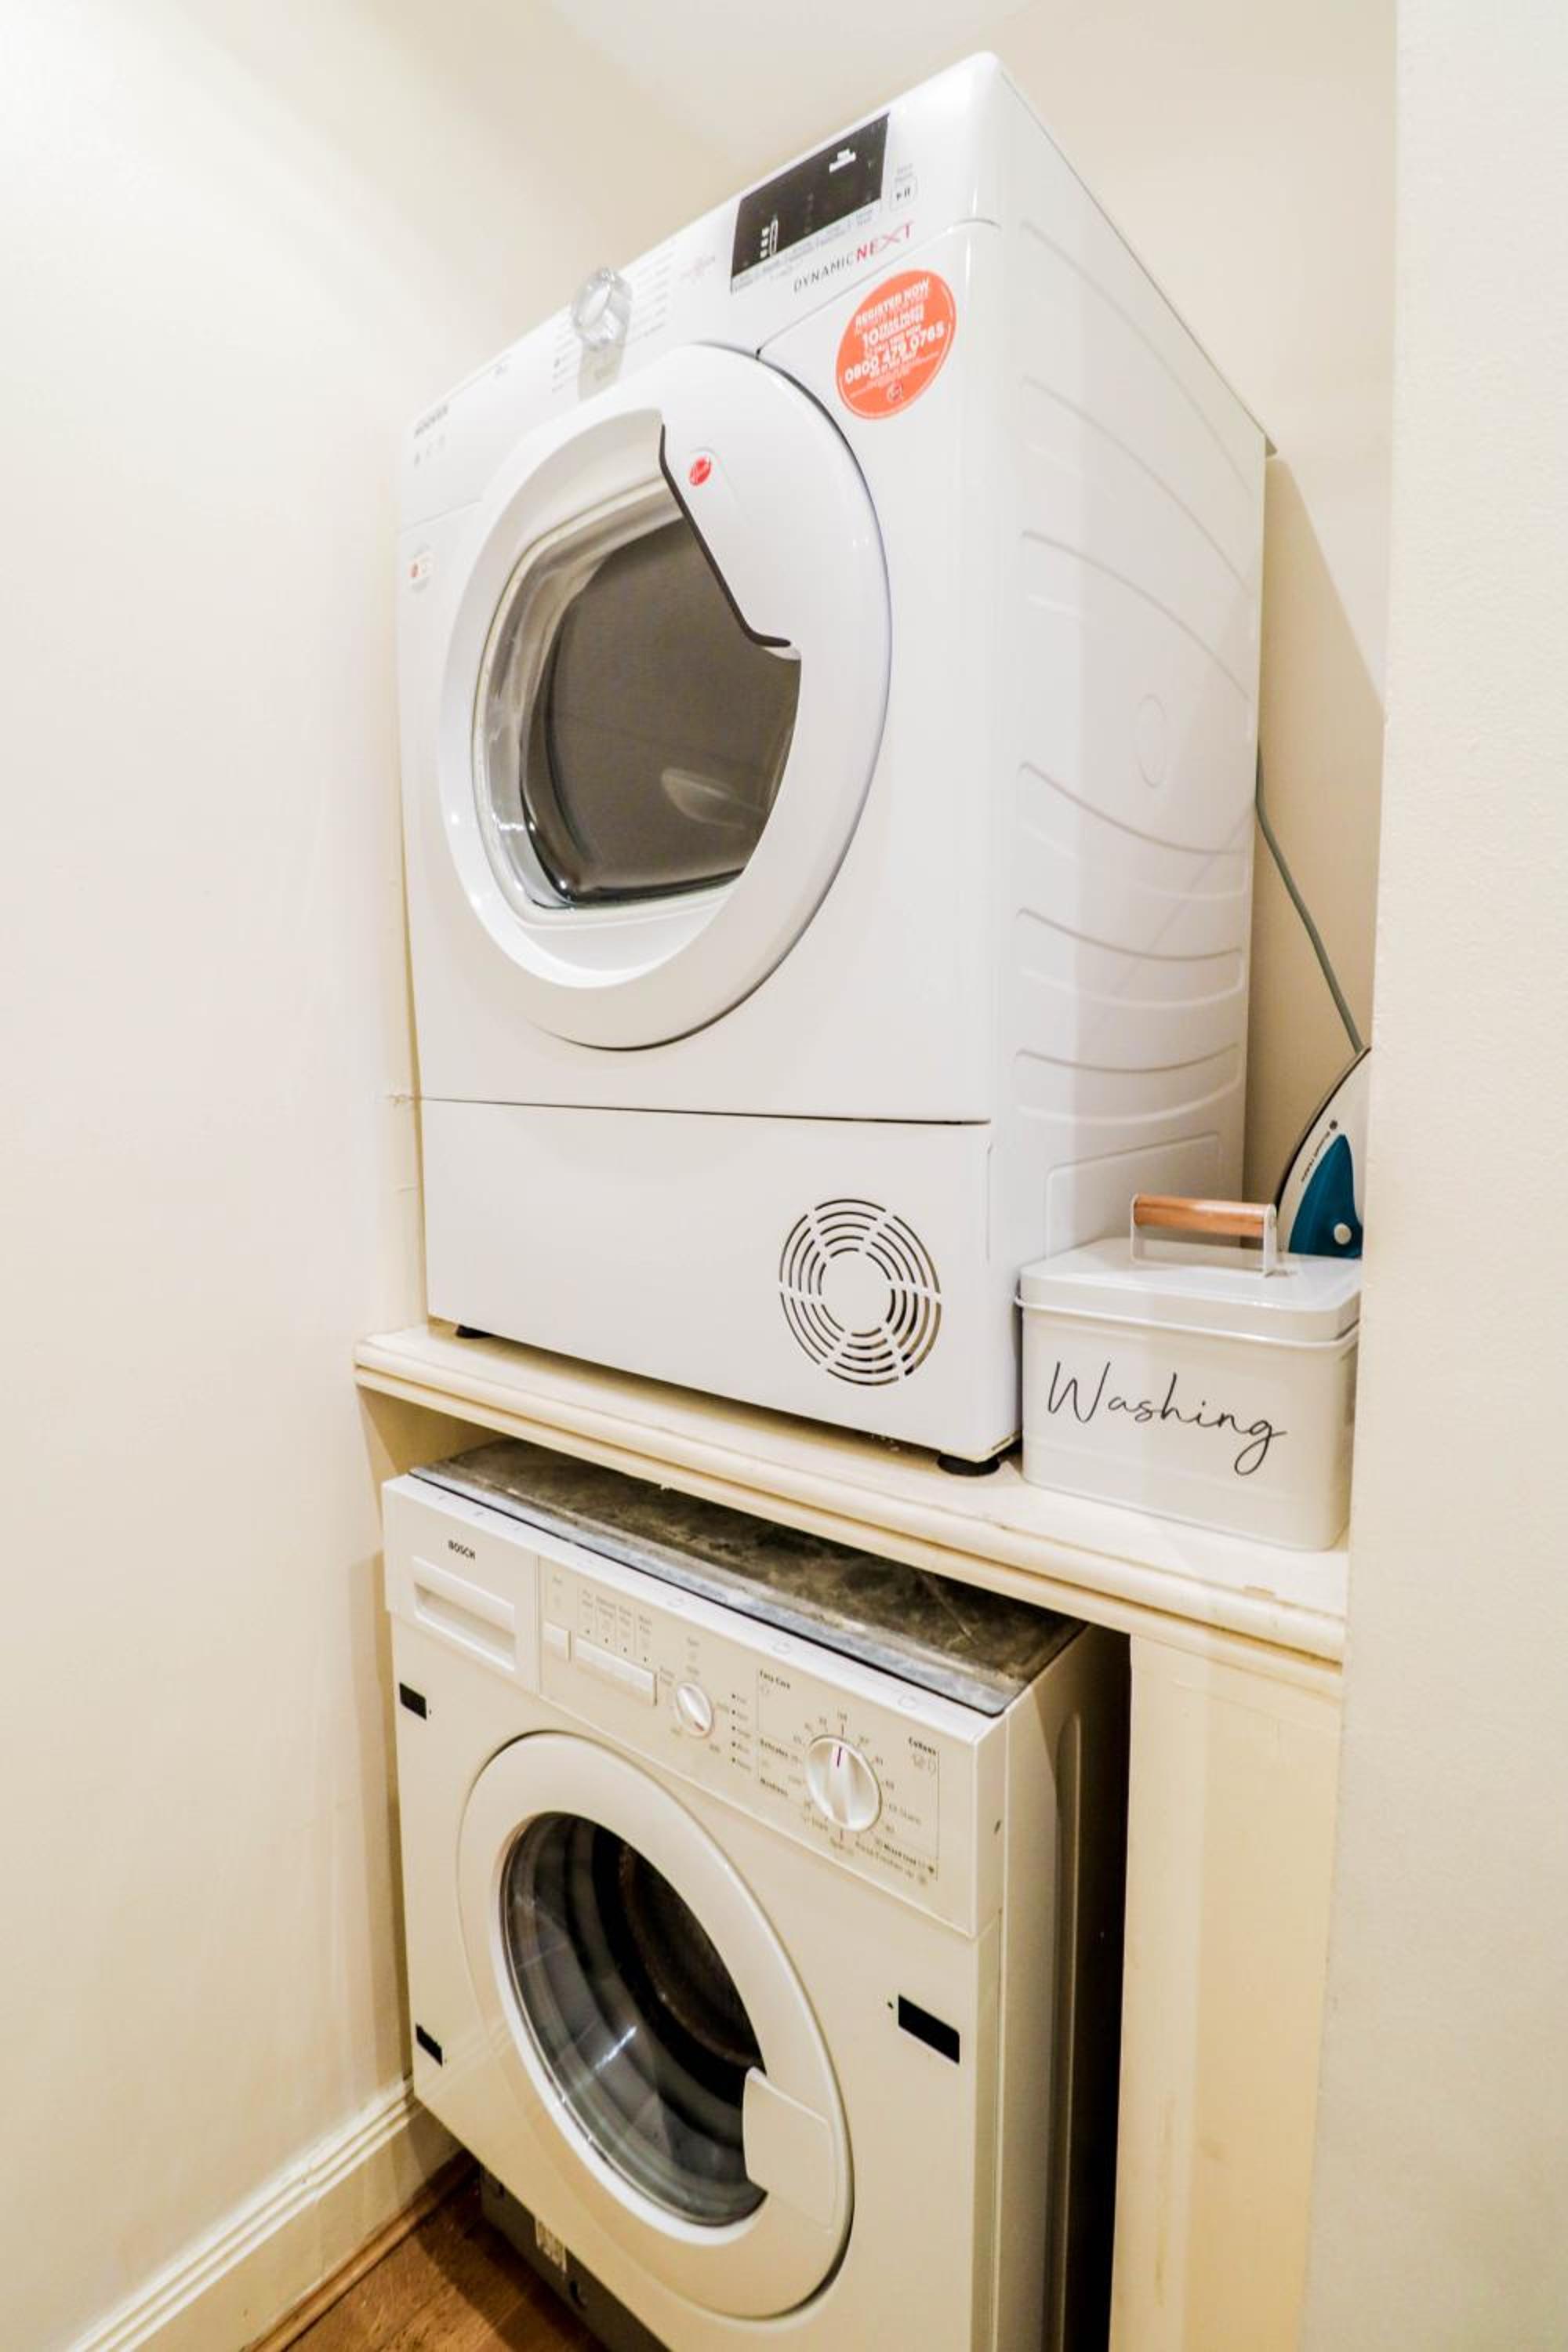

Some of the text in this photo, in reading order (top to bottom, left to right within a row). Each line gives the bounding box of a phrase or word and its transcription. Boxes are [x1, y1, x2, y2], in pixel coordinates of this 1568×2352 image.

[903, 277, 931, 299] NOW
[844, 356, 880, 383] 0800
[1047, 1362, 1287, 1475] Washing
[448, 1540, 476, 1560] BOSCH
